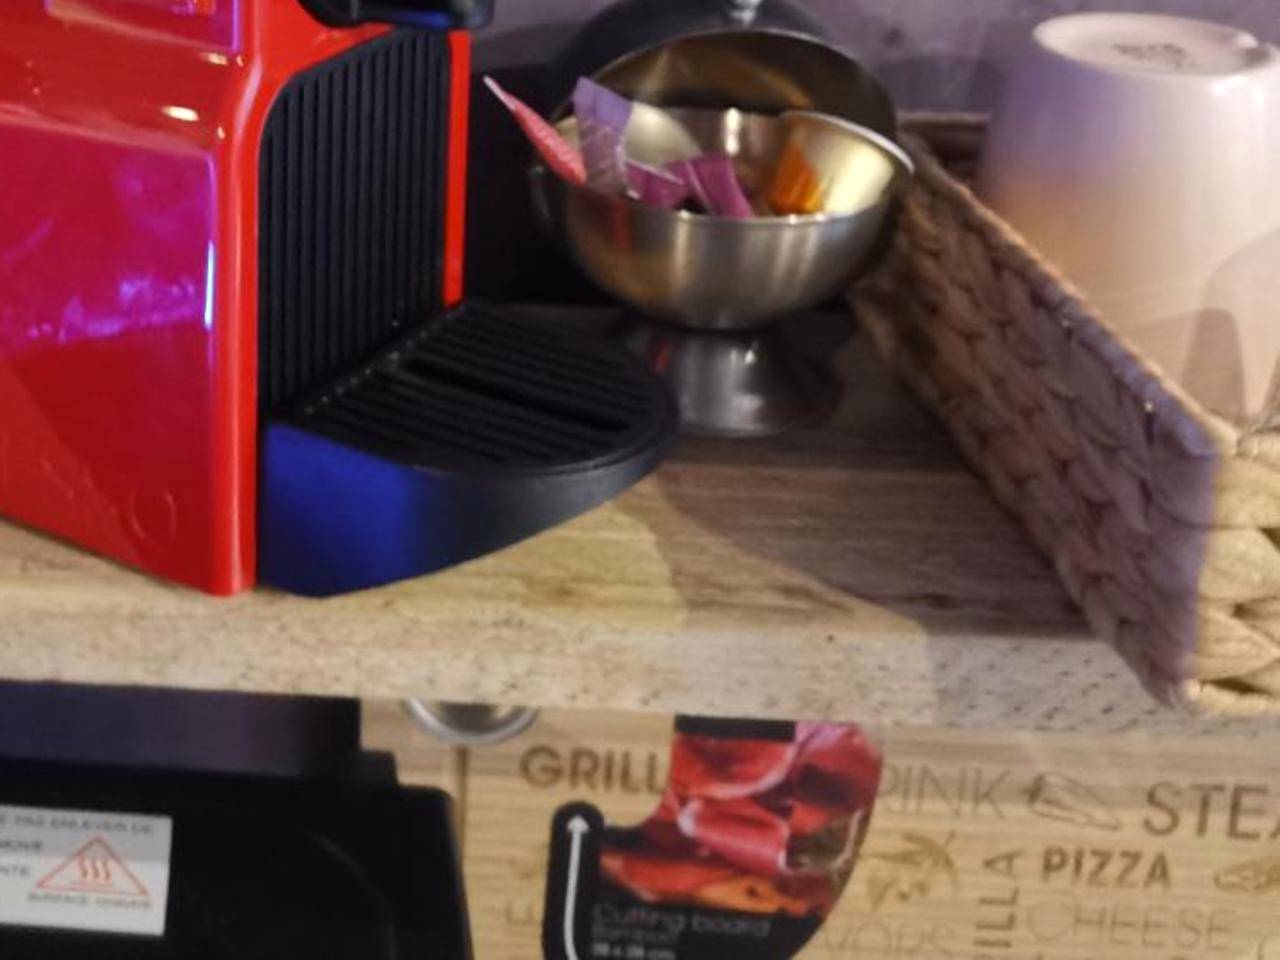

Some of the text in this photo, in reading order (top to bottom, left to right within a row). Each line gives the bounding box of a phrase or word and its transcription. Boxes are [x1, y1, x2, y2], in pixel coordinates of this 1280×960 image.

[521, 744, 669, 795] GRILL
[878, 762, 1012, 821] RINK
[1142, 781, 1280, 841] STE
[1041, 845, 1171, 889] PIZZA
[1026, 902, 1234, 951] CHEESE
